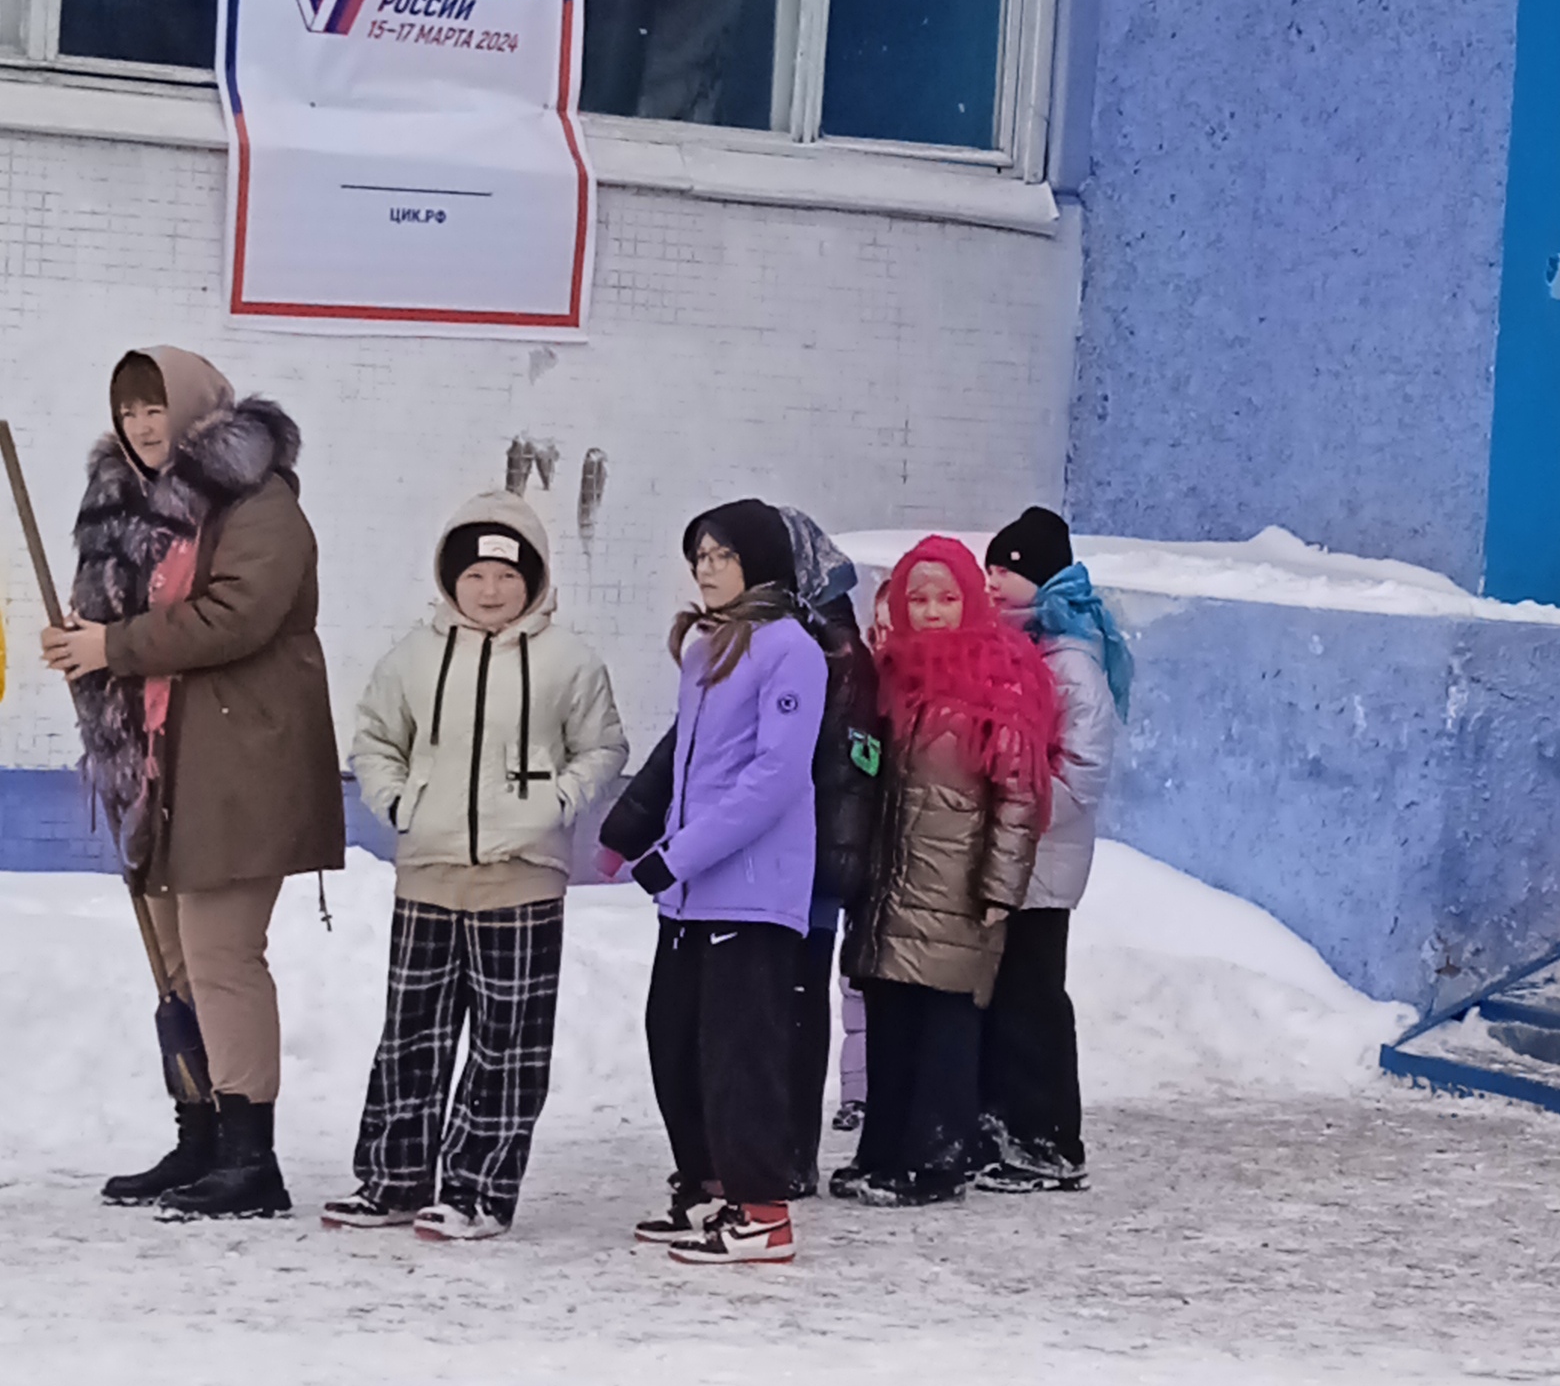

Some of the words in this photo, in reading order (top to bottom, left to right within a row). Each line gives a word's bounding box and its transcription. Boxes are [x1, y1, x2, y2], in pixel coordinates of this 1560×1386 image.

[414, 24, 473, 49] МАРТА
[475, 31, 518, 53] 2024
[389, 207, 446, 224] ЦИК.РФ
